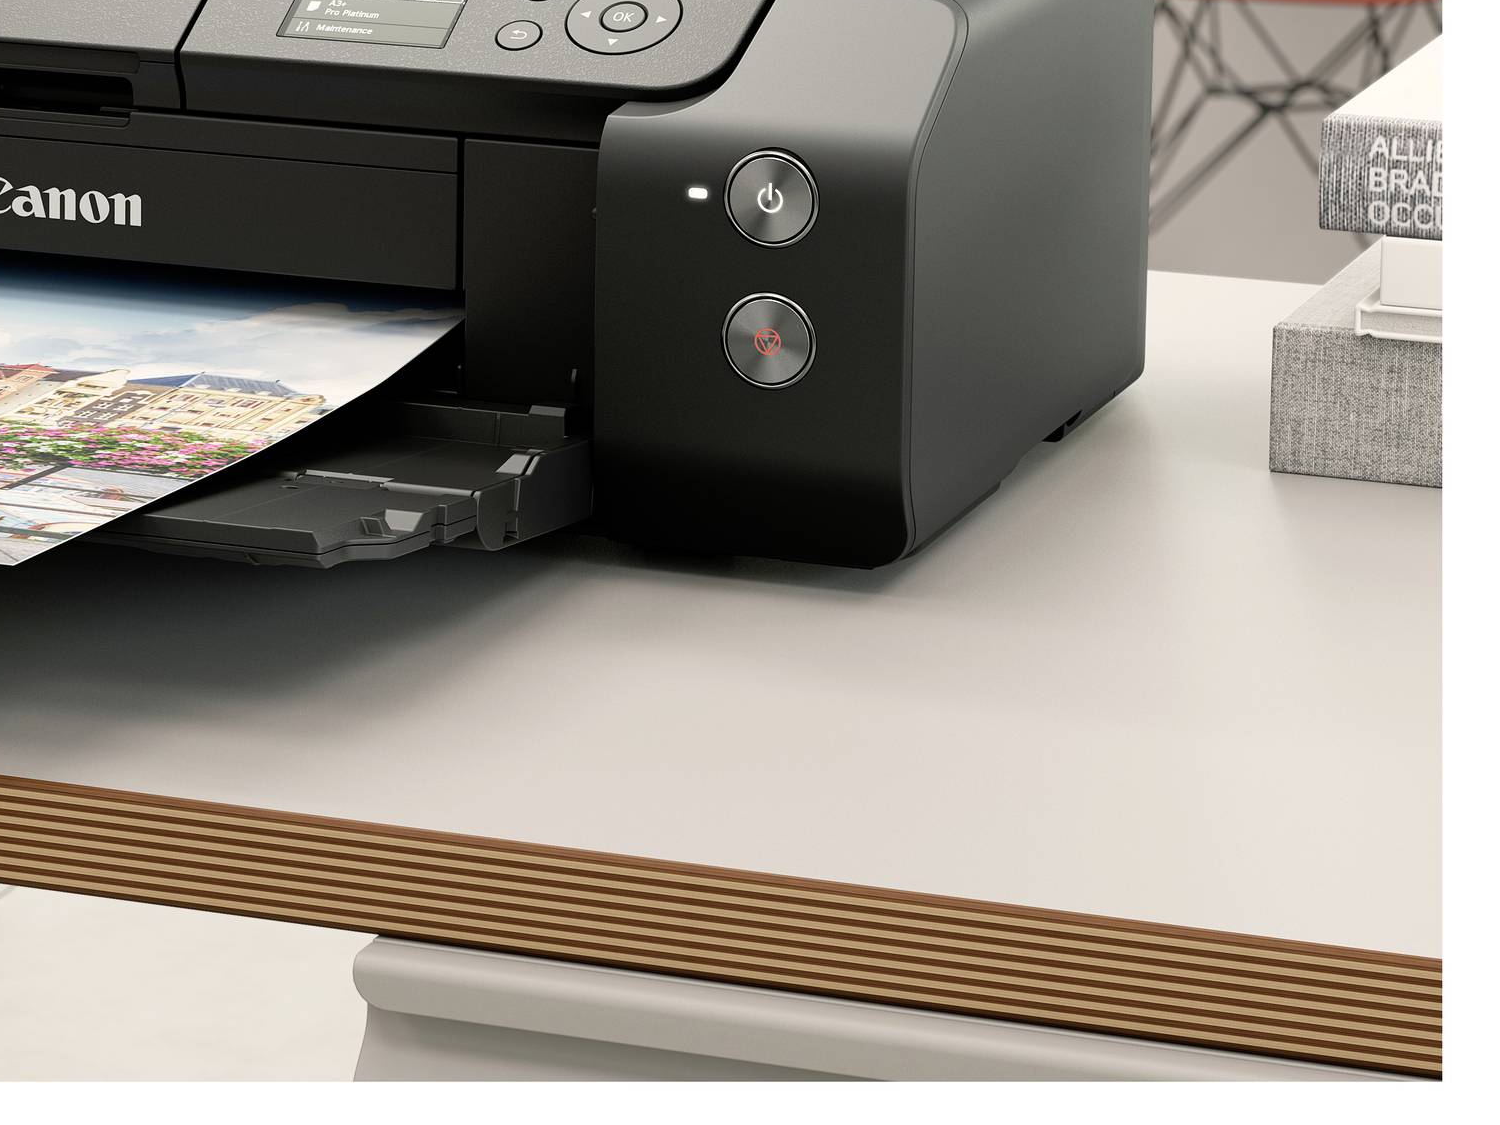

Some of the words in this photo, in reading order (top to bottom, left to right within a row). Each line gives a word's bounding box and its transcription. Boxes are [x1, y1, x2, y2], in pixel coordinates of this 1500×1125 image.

[324, 8, 340, 17] Pro
[342, 9, 380, 19] Platinum
[613, 11, 635, 23] OK
[316, 24, 373, 35] Maintenance
